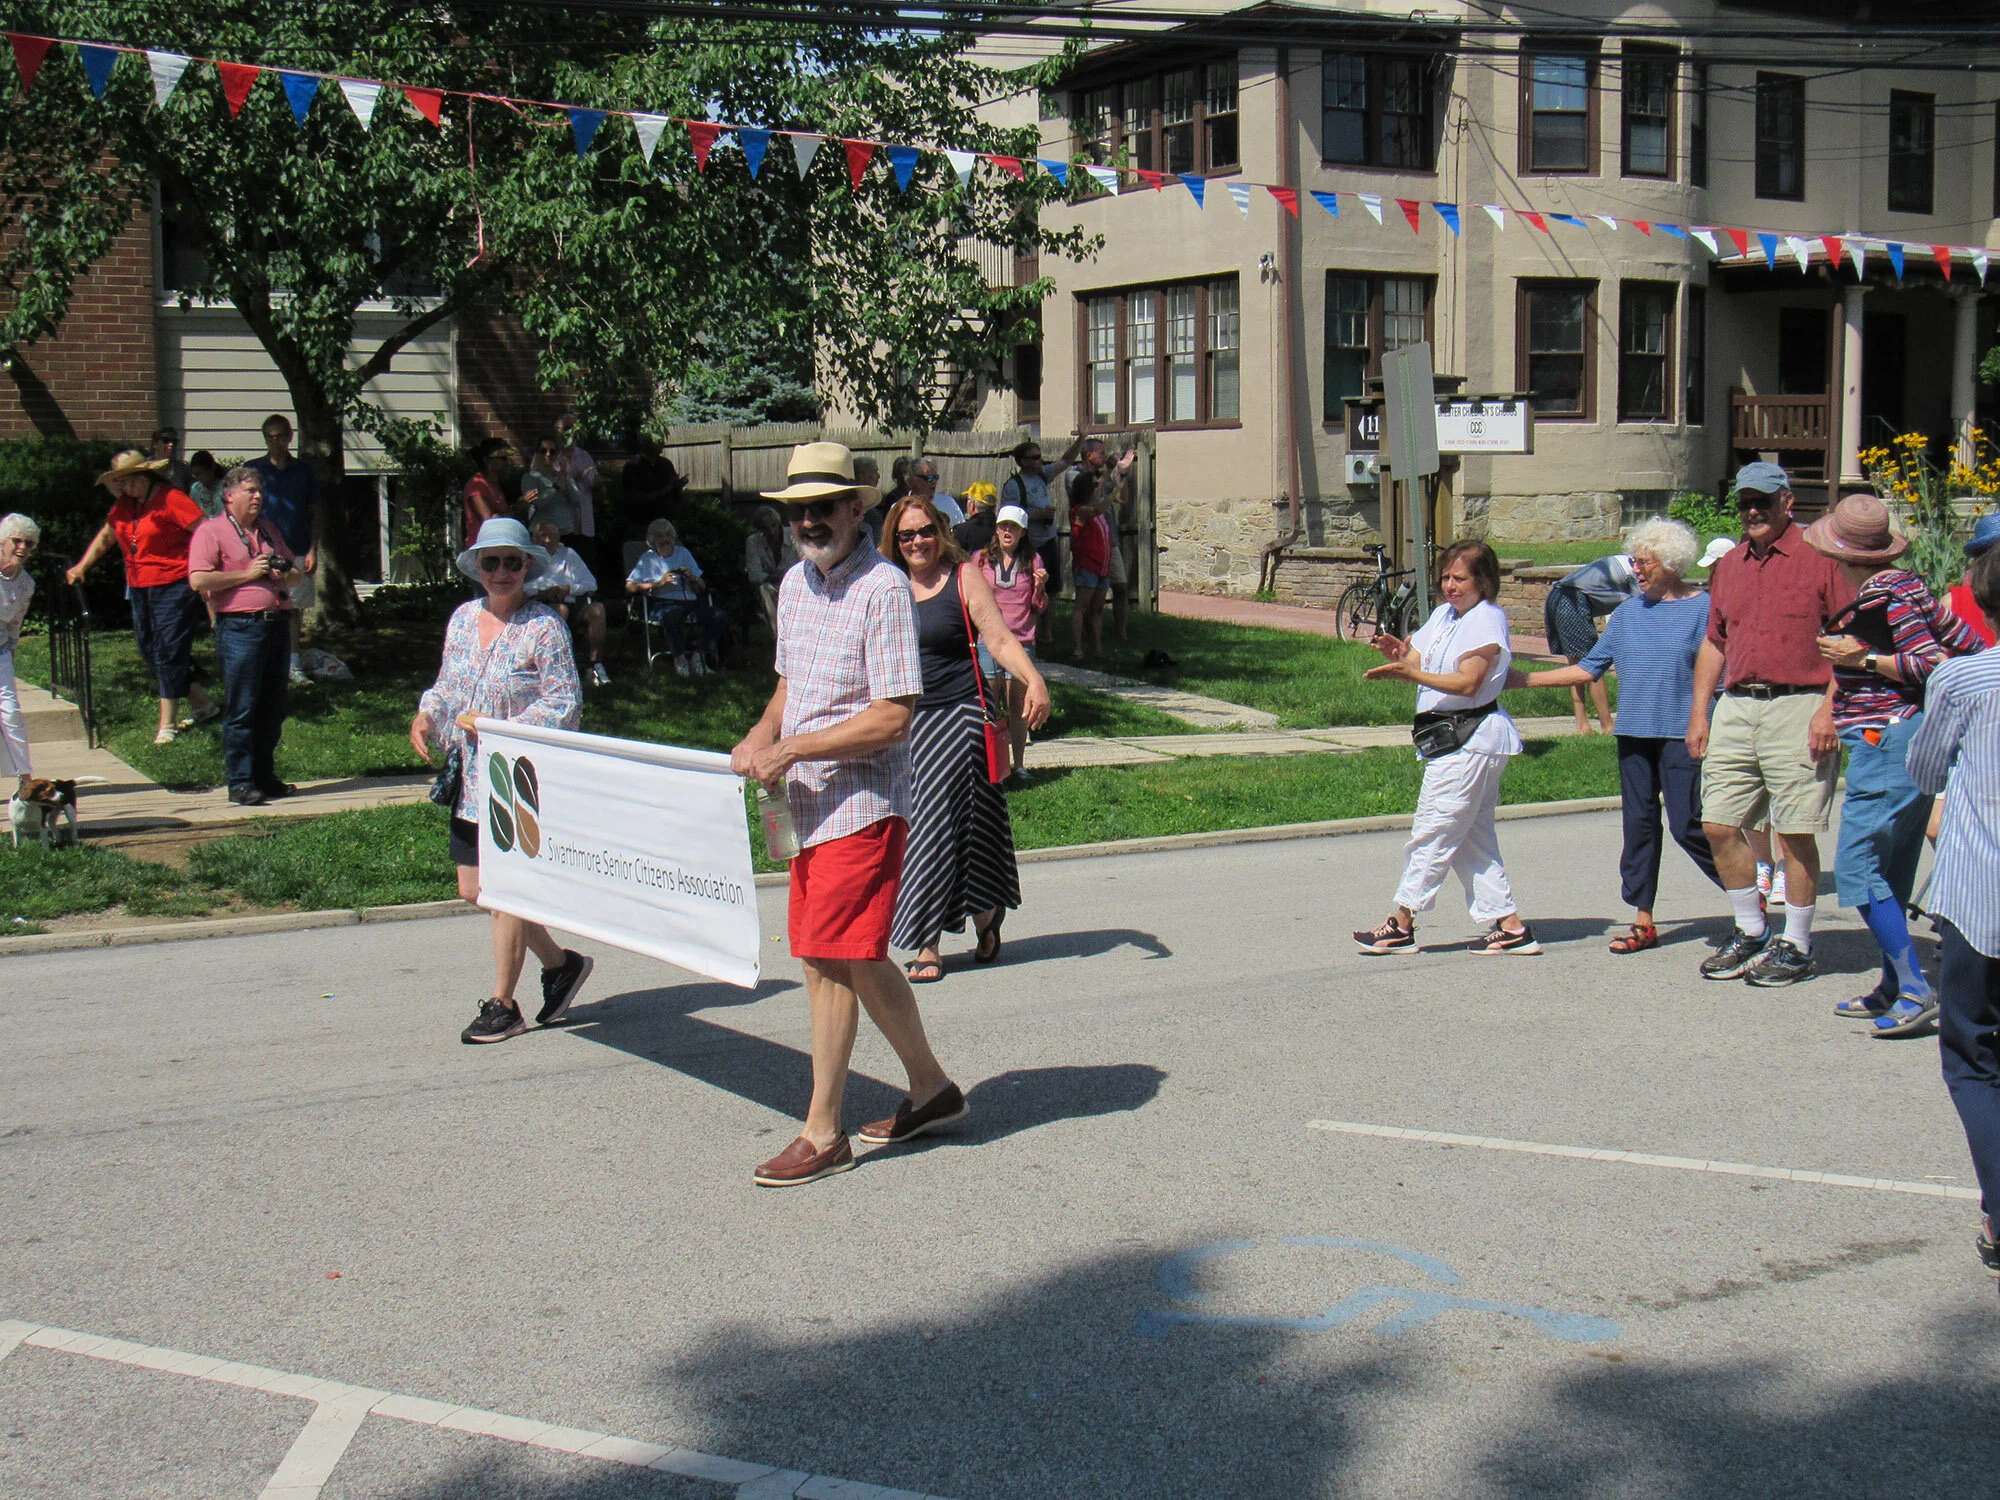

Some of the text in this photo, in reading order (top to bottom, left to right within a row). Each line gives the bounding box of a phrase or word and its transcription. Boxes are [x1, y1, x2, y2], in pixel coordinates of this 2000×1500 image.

[548, 837, 745, 905] Swarthmore Senior Citizens Association
